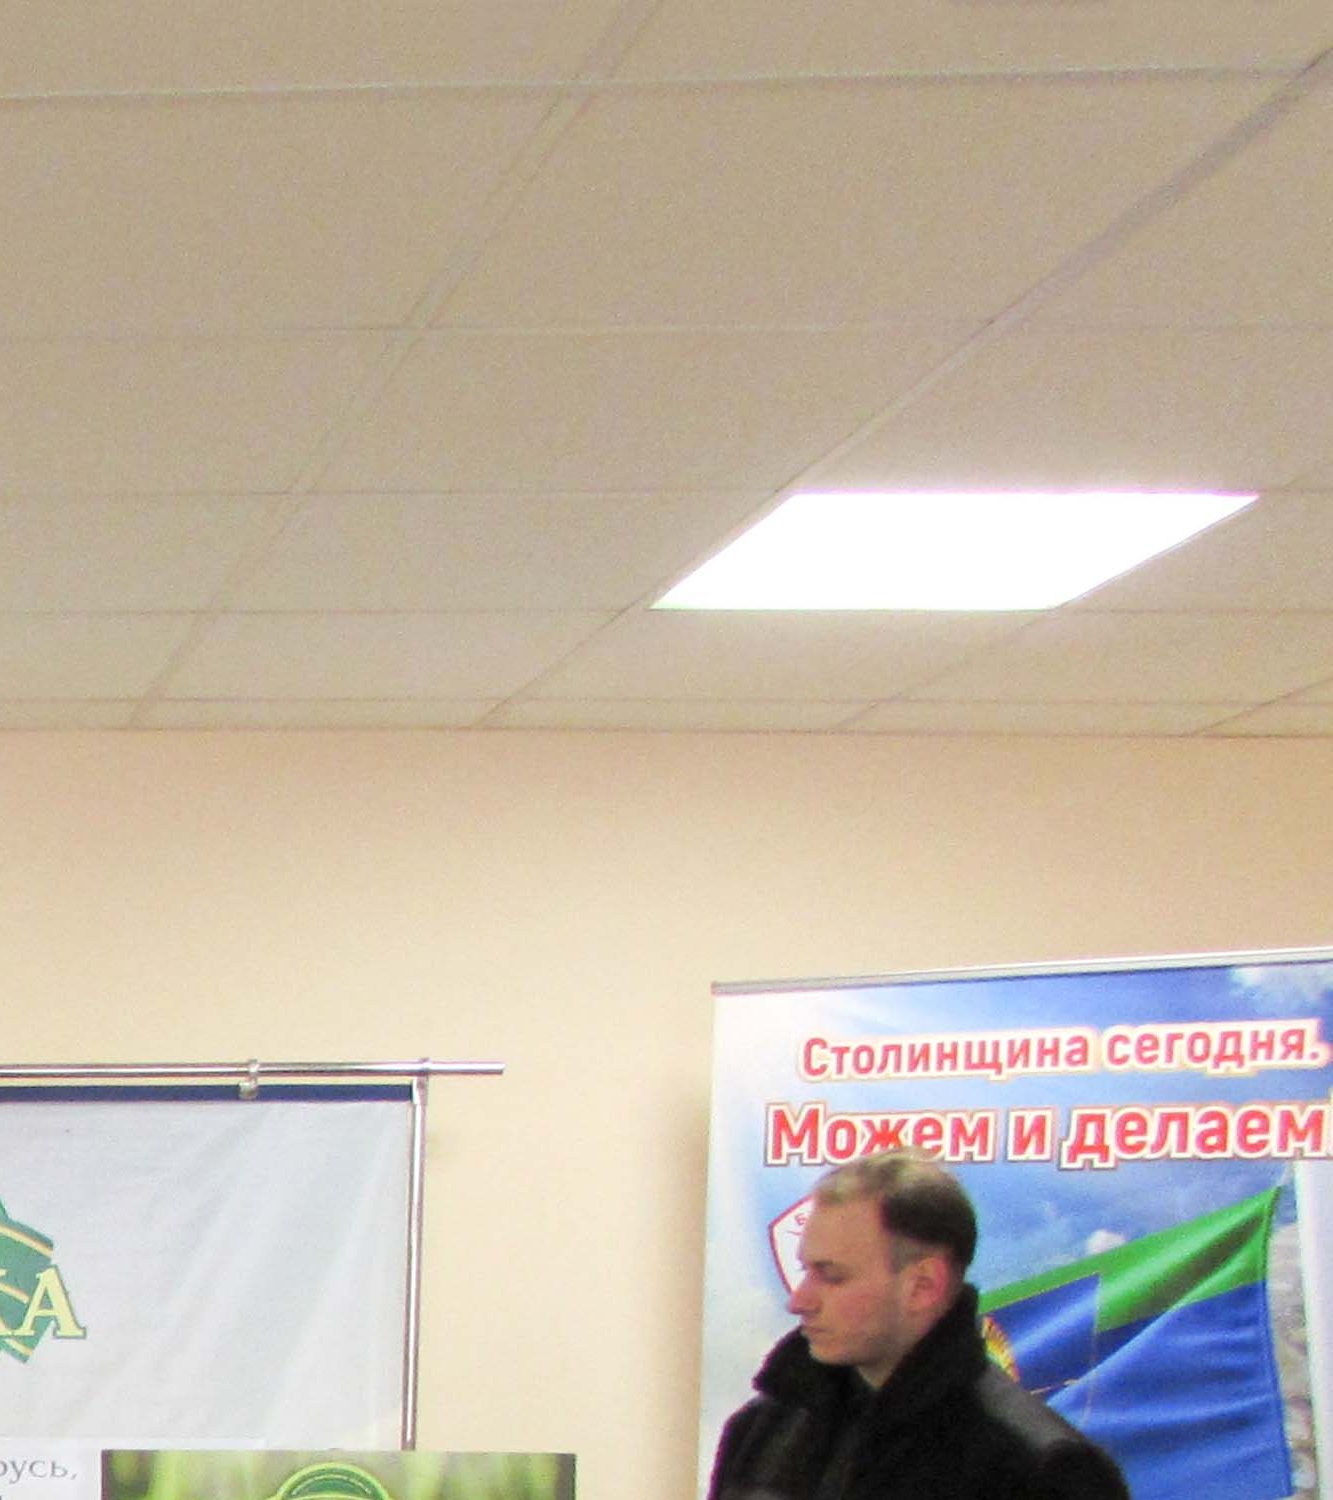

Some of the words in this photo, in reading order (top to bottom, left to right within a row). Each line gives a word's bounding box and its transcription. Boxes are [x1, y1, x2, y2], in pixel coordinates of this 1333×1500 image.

[802, 1033, 1090, 1077] Столинщина
[1106, 1025, 1320, 1070] сегодня.
[770, 1107, 991, 1161] Можем
[1014, 1115, 1047, 1156] и
